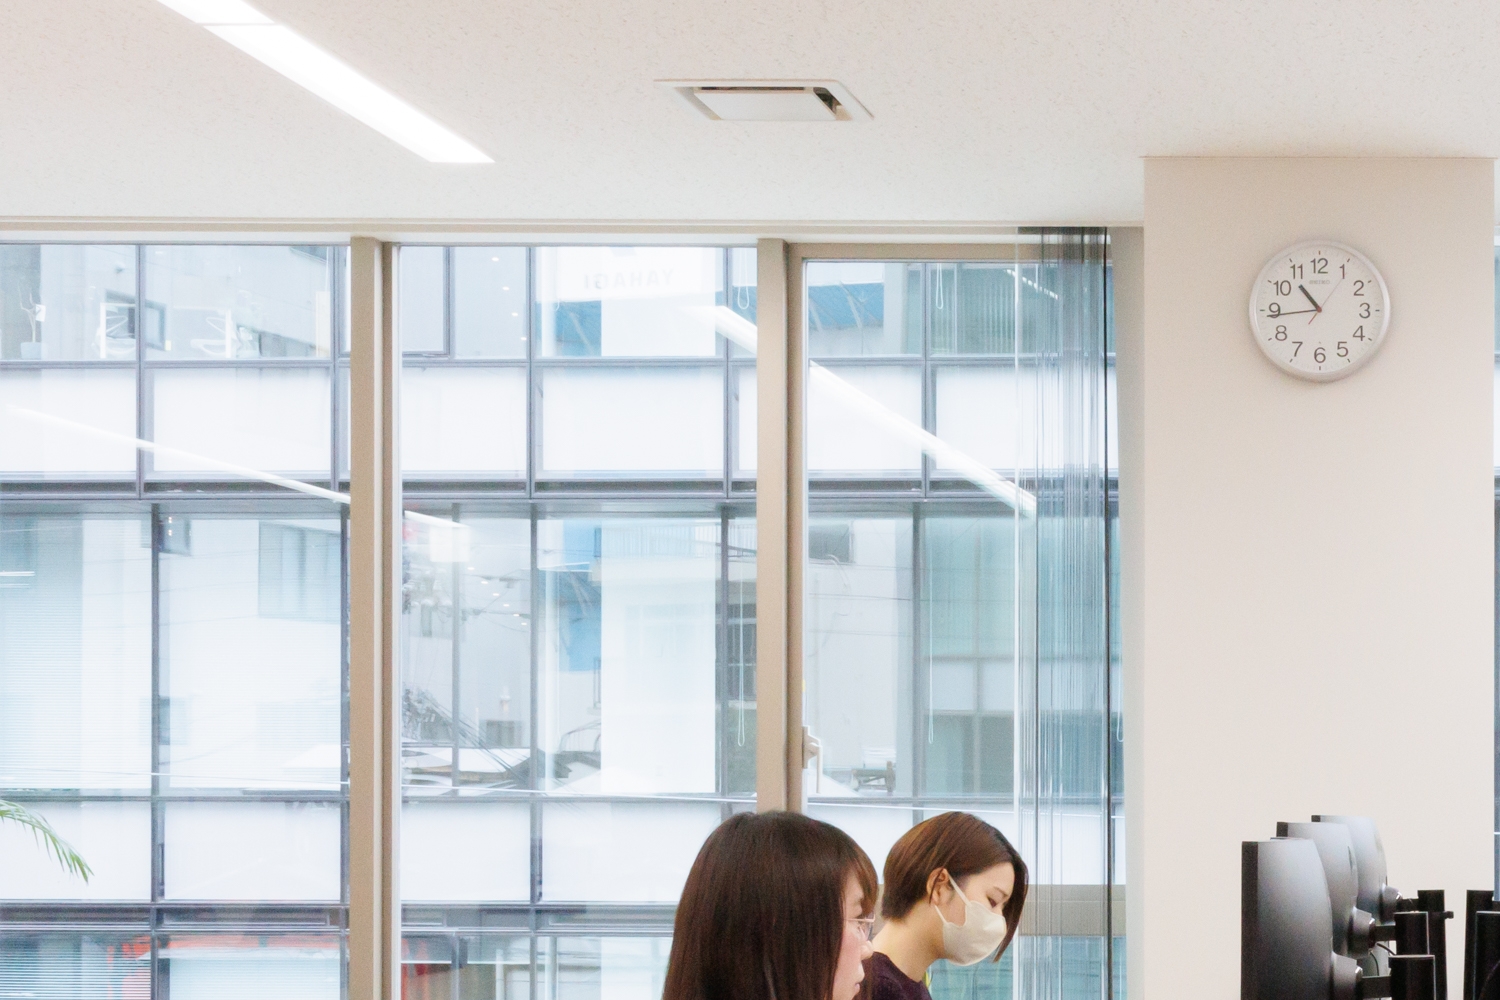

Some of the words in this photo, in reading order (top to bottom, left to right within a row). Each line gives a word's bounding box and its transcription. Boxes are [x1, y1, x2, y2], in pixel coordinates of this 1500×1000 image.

[1289, 264, 1304, 280] 11
[1310, 257, 1329, 274] 12
[1339, 263, 1346, 280] 1
[1273, 280, 1292, 296] 10
[1353, 280, 1365, 297] 2
[1268, 302, 1281, 319] 9
[1358, 302, 1371, 319] 3
[1274, 325, 1288, 341] 8
[1352, 325, 1366, 342] 4
[1291, 341, 1304, 357] 7
[1313, 347, 1327, 364] 6
[1336, 341, 1349, 358] 5
